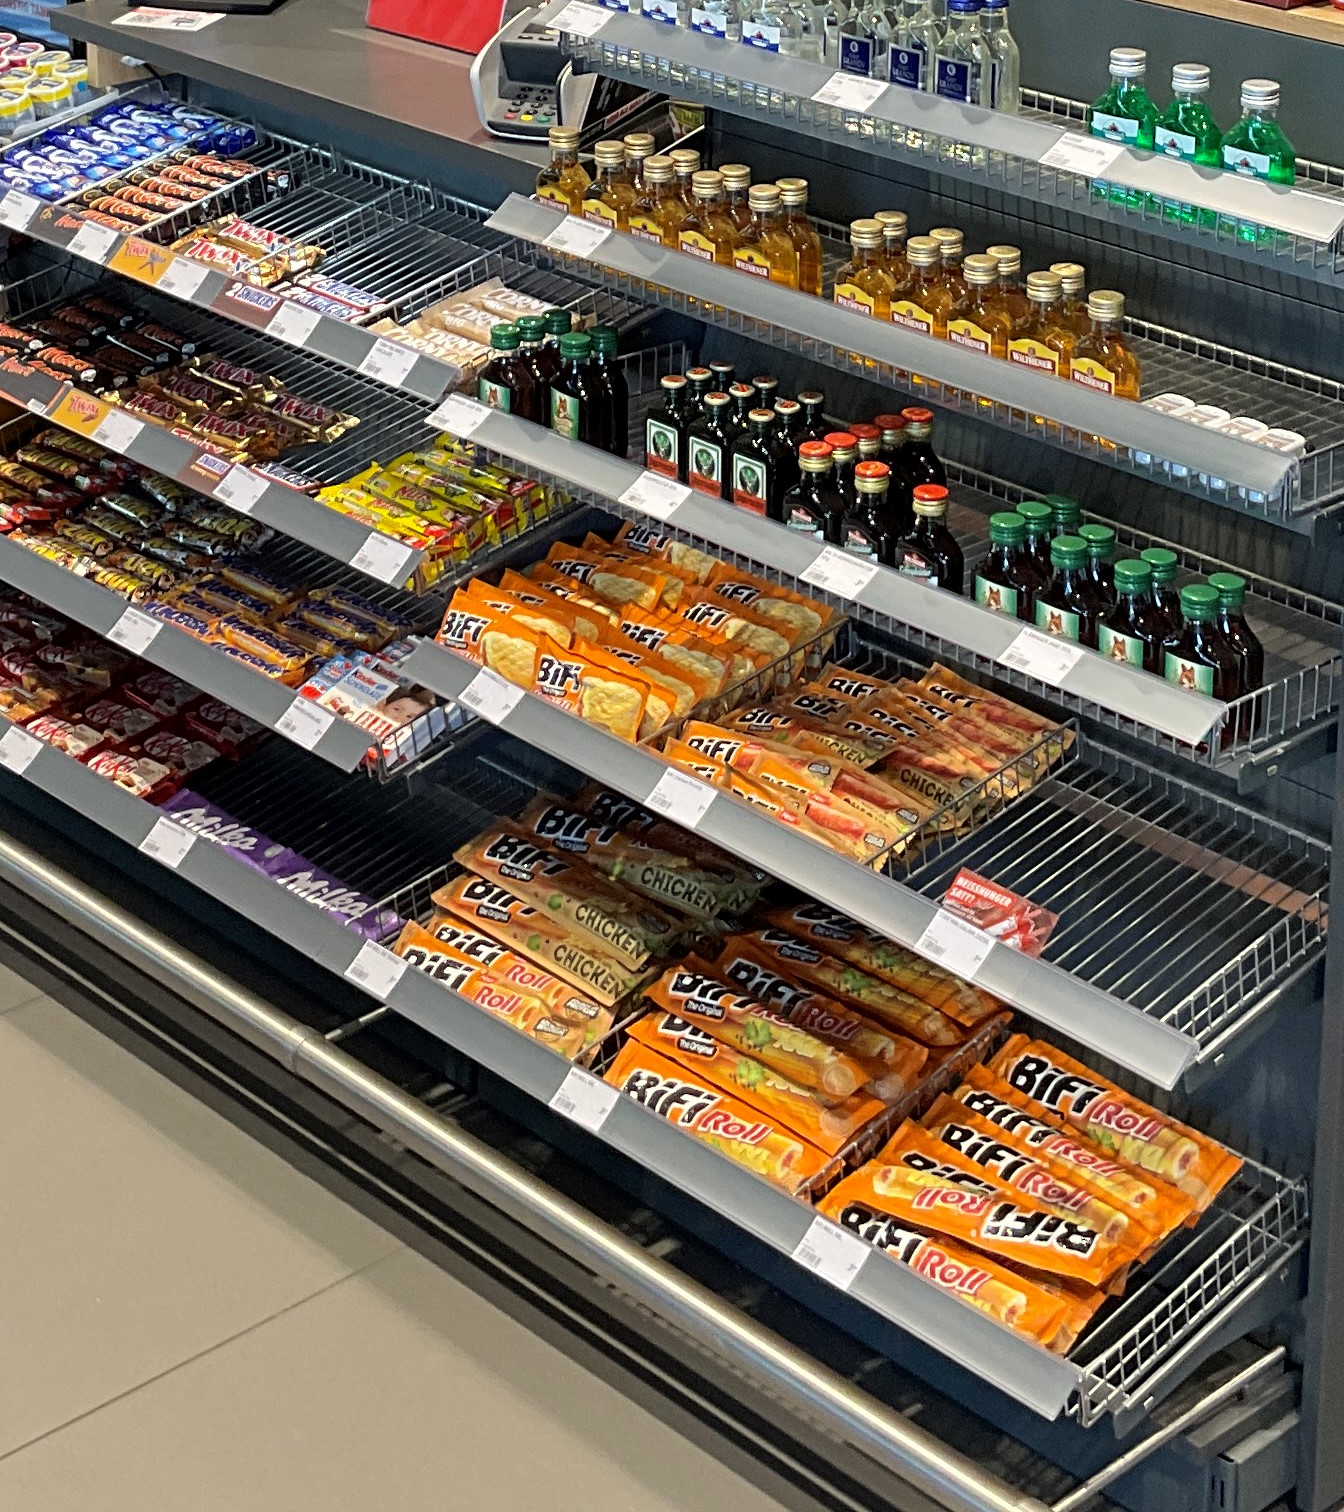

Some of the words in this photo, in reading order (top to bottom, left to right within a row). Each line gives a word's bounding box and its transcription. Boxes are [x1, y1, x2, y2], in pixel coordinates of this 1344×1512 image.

[219, 218, 279, 245] TWIX
[184, 238, 240, 268] TWIX
[238, 287, 280, 310] SNICKERS
[485, 285, 559, 313] CORNY
[206, 359, 255, 386] TWIX
[273, 393, 330, 422] TWIX
[193, 413, 250, 439] TWIX
[171, 806, 260, 853] Milka
[275, 870, 369, 926] Milka
[640, 866, 717, 914] CHICKEN
[575, 904, 647, 961] CHICKEN
[508, 963, 554, 990] Roll
[554, 944, 624, 998] CHICKEN
[475, 985, 521, 1015] Roll
[800, 1006, 861, 1040] Roll
[702, 1107, 774, 1143] Roll
[1091, 1102, 1166, 1142] Roll
[1049, 1138, 1124, 1176] Roll
[912, 1188, 992, 1216] Roll
[1018, 1170, 1092, 1211] Roll
[916, 1248, 992, 1293] Roll
